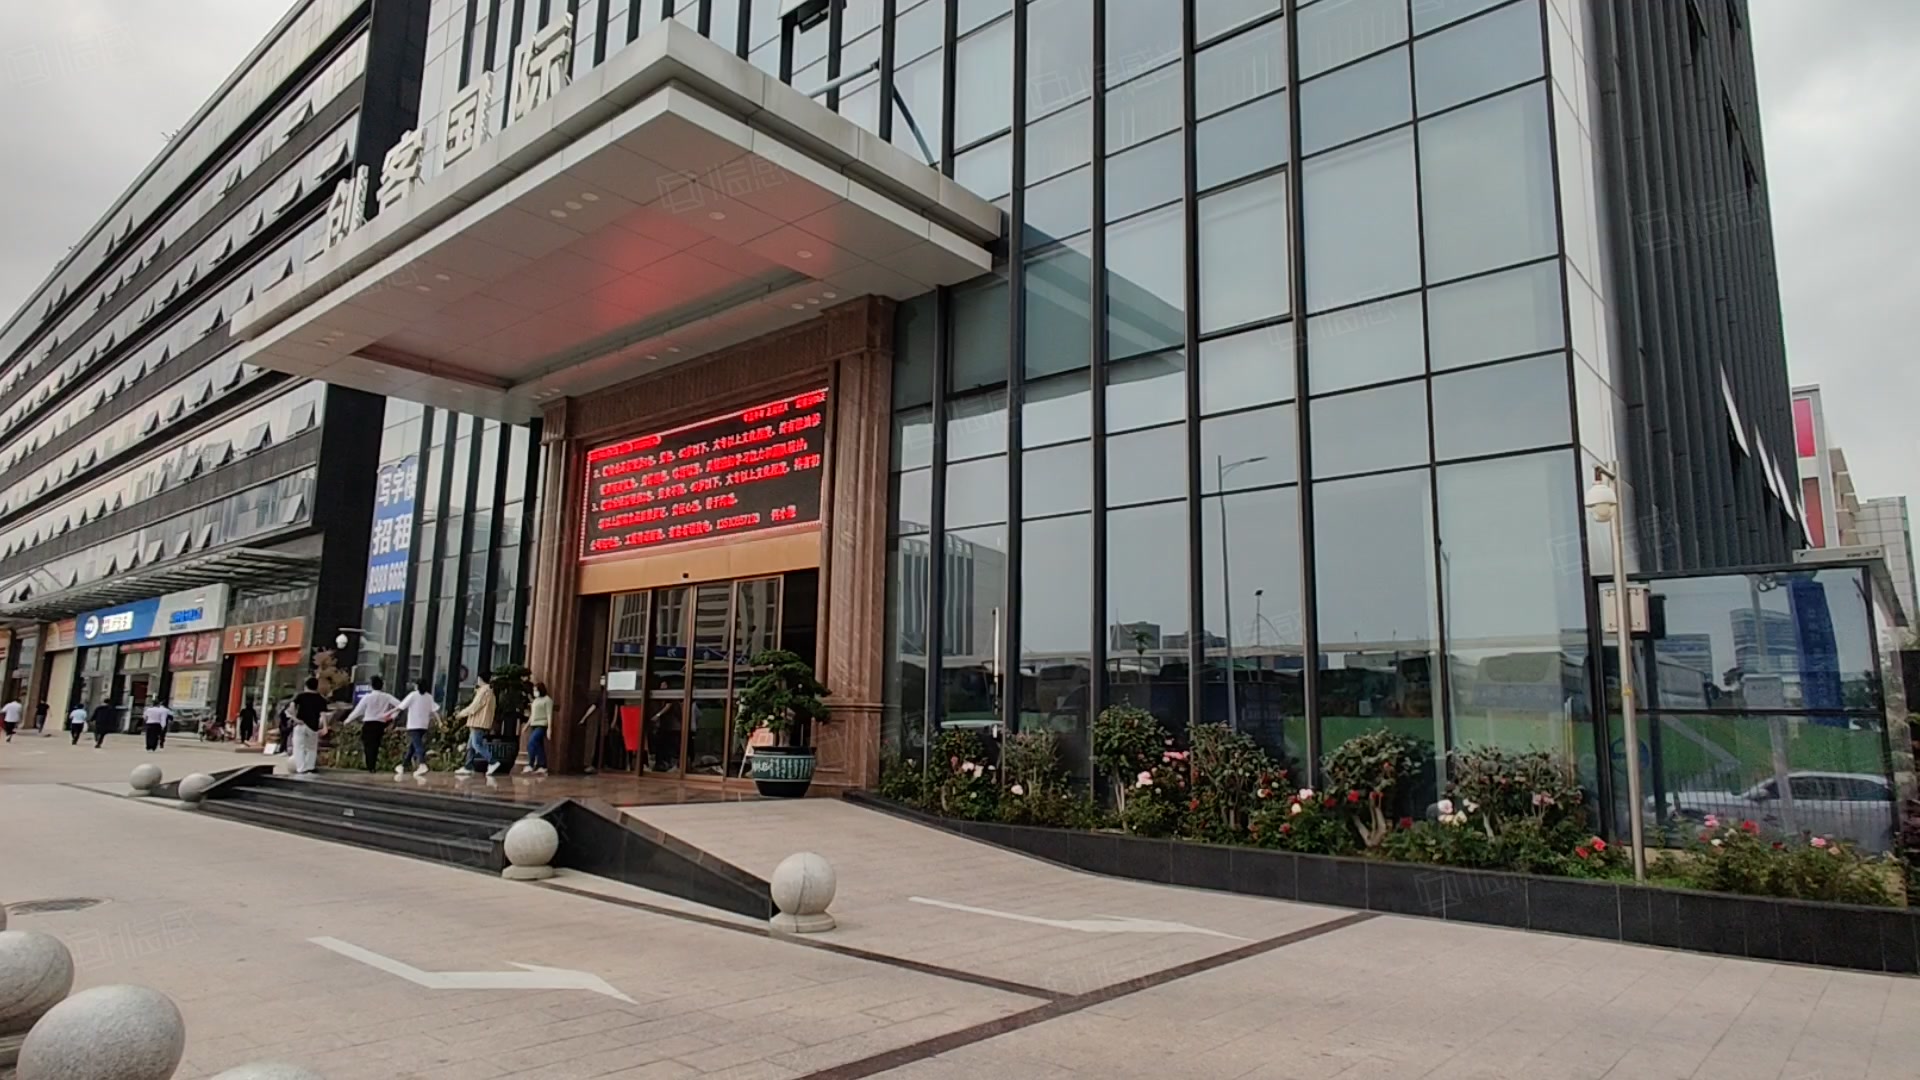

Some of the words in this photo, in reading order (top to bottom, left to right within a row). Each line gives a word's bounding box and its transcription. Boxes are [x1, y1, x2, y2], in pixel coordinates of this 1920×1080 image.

[327, 13, 573, 247] 创客国际
[373, 512, 412, 556] 招租
